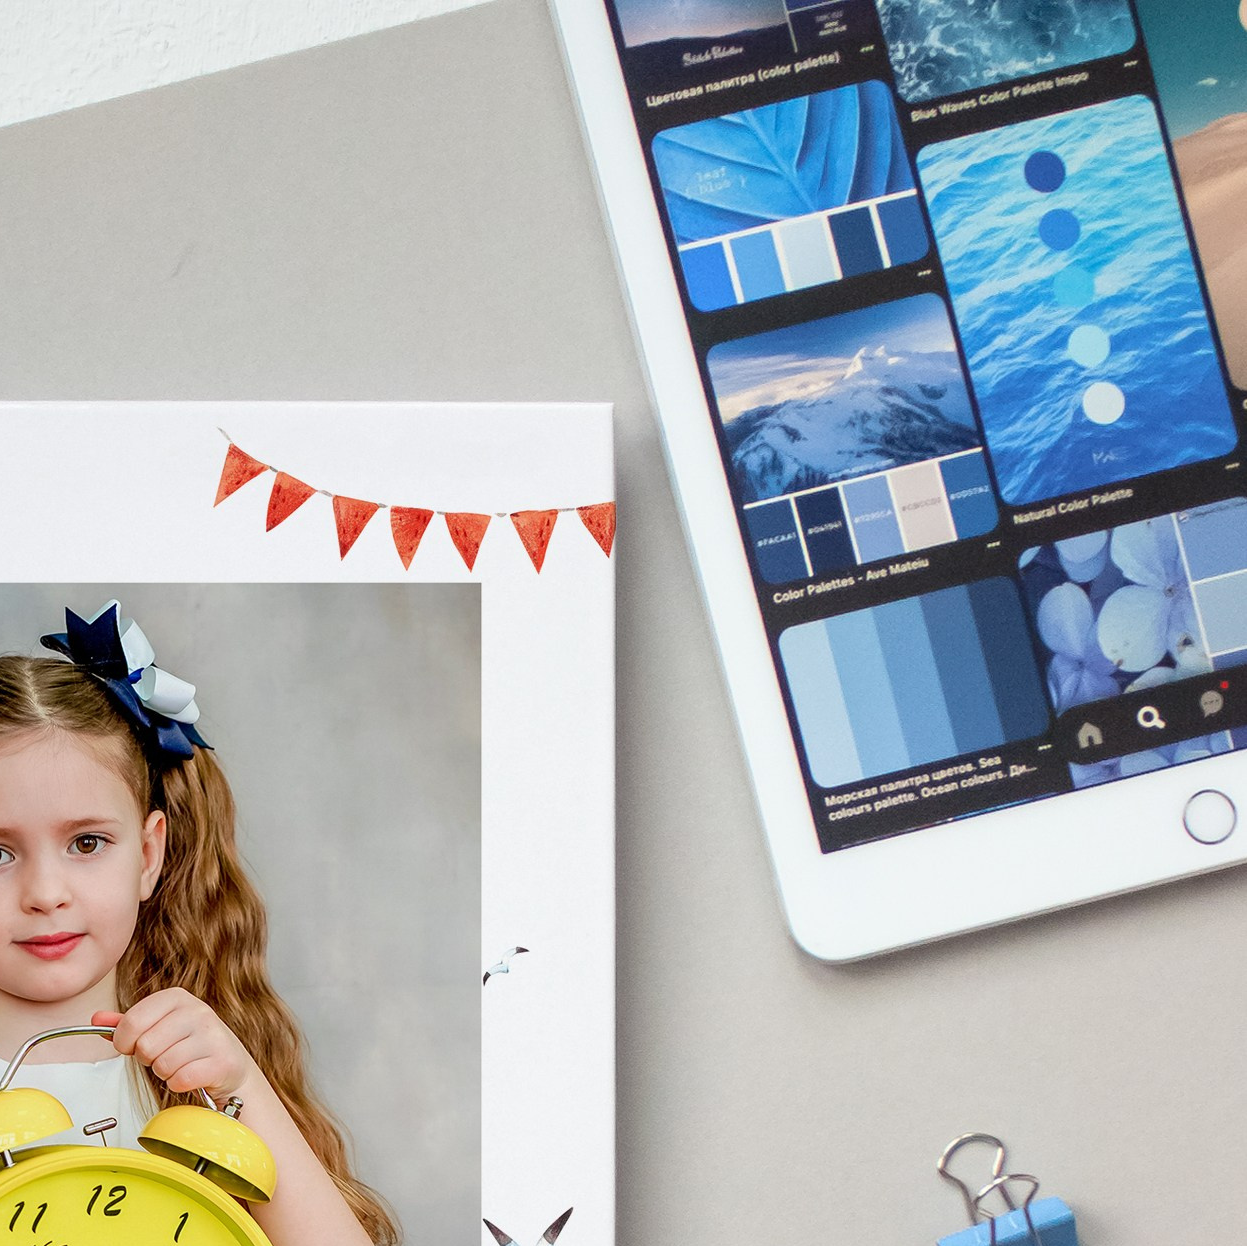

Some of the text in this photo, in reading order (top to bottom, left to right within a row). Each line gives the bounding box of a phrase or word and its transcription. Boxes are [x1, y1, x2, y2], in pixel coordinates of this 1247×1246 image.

[646, 50, 841, 108] Цветовая палитра (color palette)
[911, 71, 1089, 122] Blue Waves Color Palette Inspo
[1014, 489, 1133, 524] Natural Color Palette
[773, 587, 805, 604] Color
[807, 575, 855, 596] Palettes
[866, 569, 888, 582] Ave
[825, 755, 1002, 807] Морская палитра цветов. Sea
[828, 799, 872, 821] colours
[874, 791, 919, 810] palette.
[921, 782, 960, 798] Ocean
[960, 771, 1007, 789] colours.
[9, 1201, 48, 1234] 11
[86, 1184, 127, 1217] 12
[173, 1212, 189, 1243] 1
